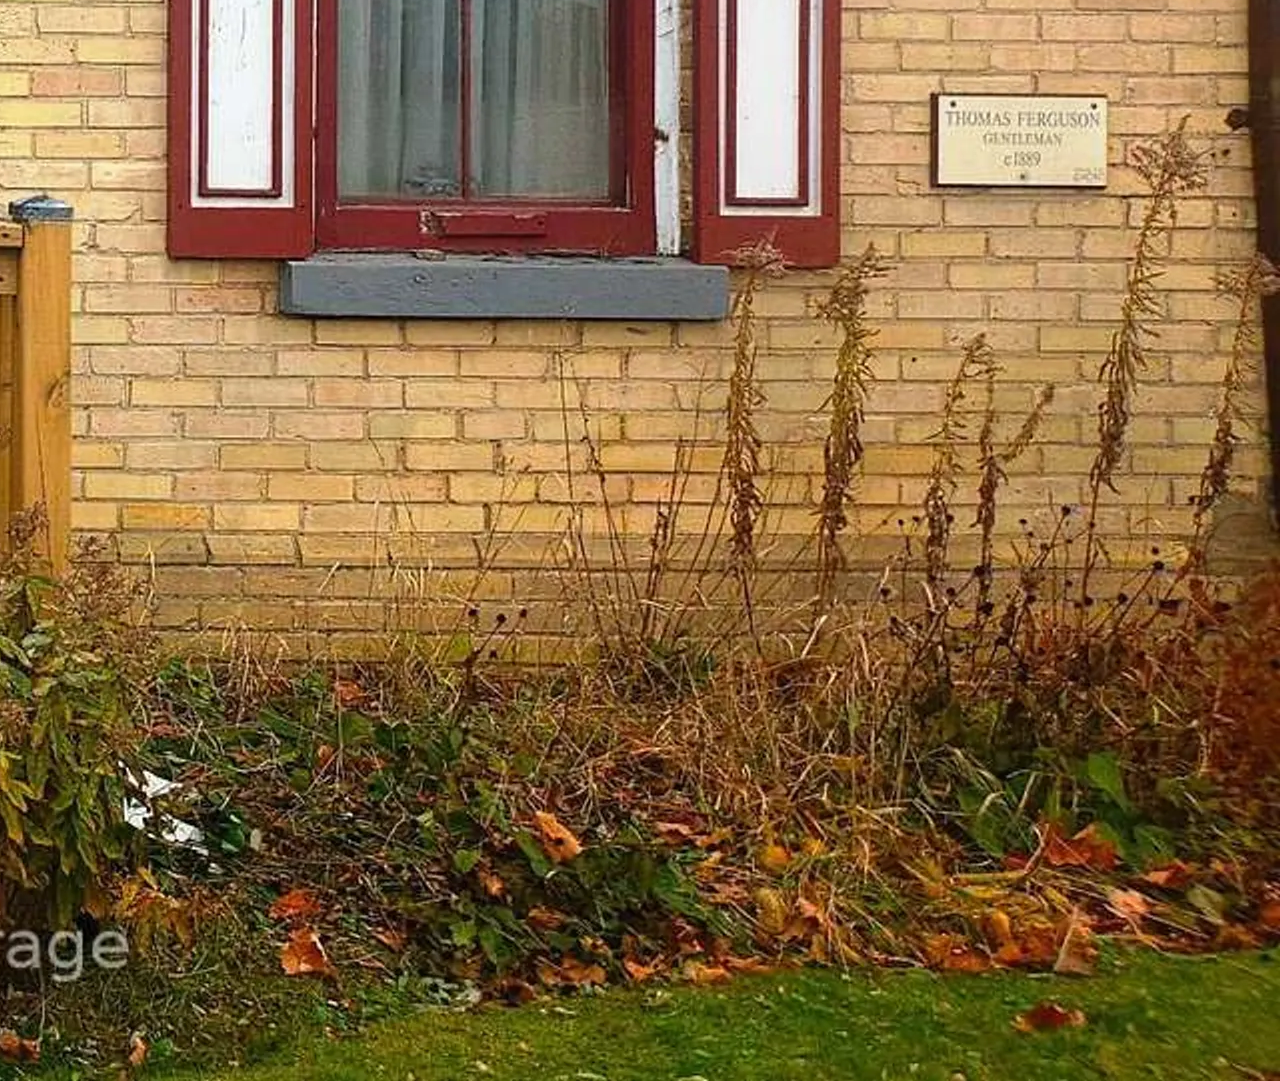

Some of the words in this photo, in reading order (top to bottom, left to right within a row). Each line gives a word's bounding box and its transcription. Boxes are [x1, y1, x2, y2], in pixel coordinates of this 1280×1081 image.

[945, 110, 1011, 127] THOMAS
[1017, 111, 1100, 128] FERGUSON
[982, 132, 1063, 146] GENTLEMAN
